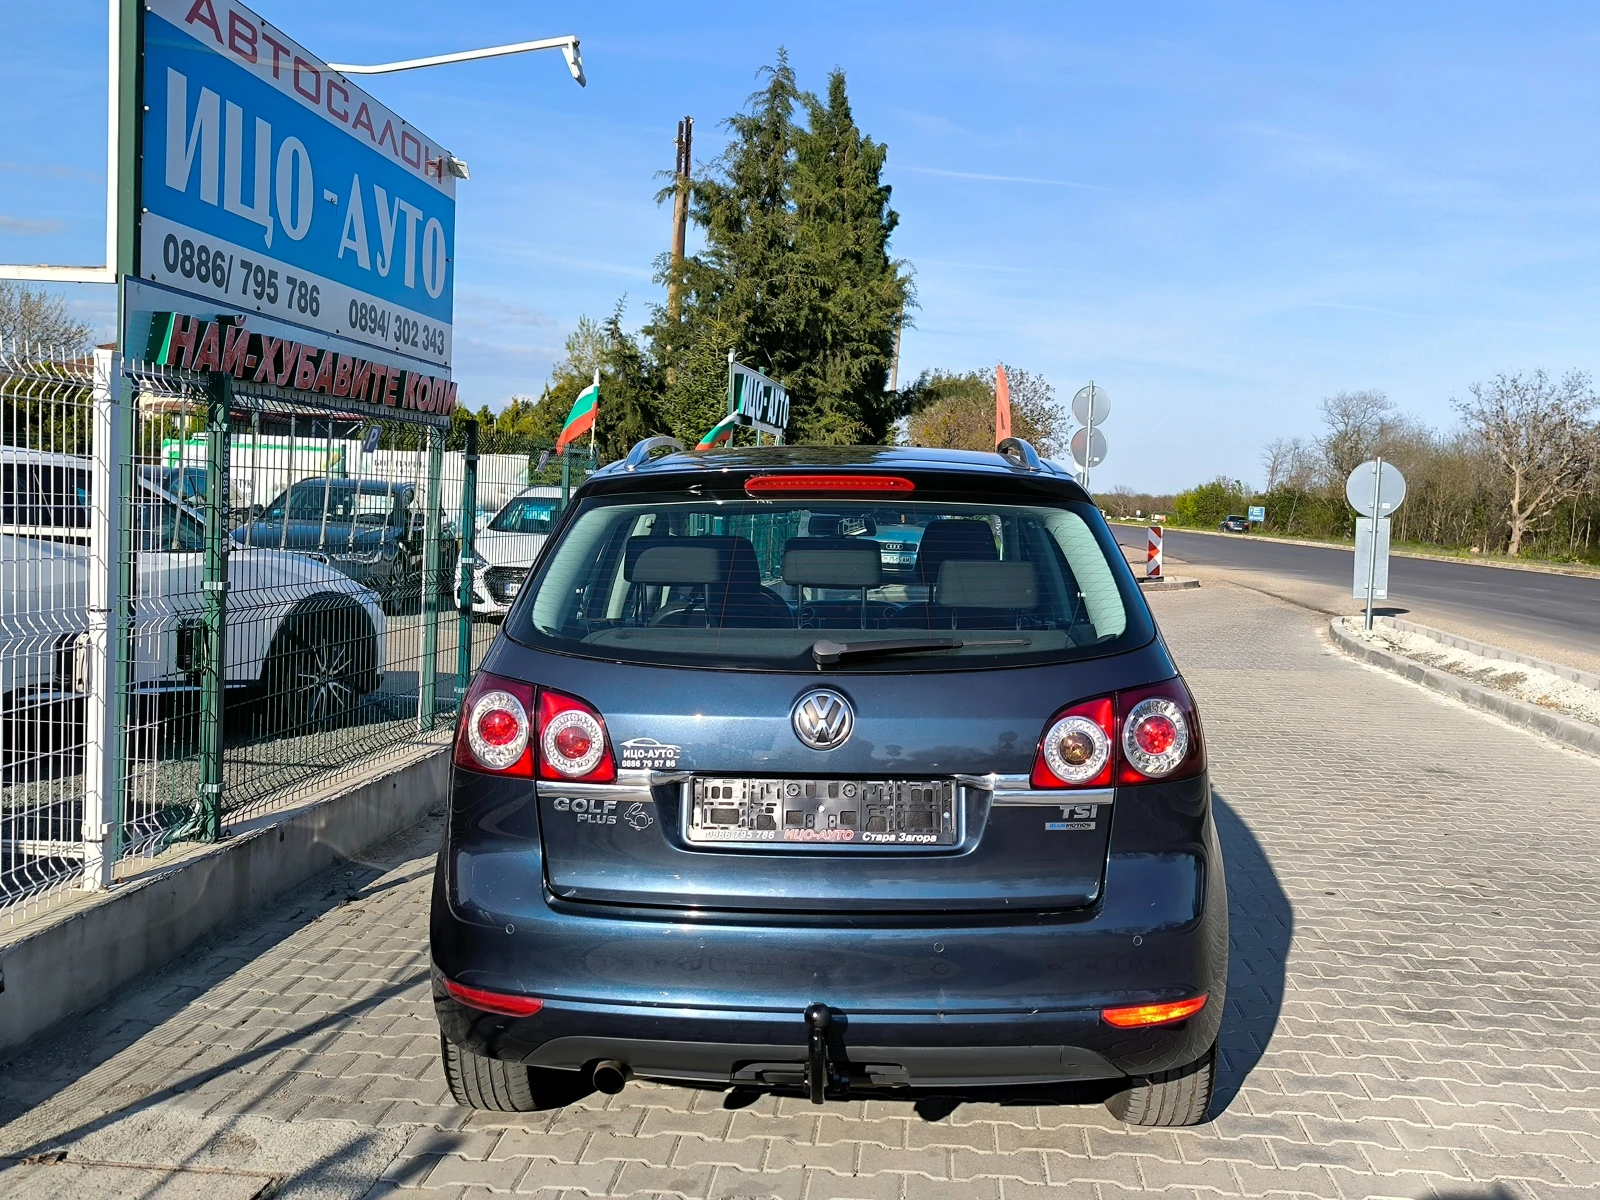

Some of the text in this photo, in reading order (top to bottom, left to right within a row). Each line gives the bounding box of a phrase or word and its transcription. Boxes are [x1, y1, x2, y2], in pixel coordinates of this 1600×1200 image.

[185, 0, 442, 184] АВТОСАЛОН
[165, 66, 446, 299] ИЦО-АУТО
[163, 233, 320, 318] 0886/ 795 786
[349, 299, 445, 356] 0894/ 302 343
[165, 311, 458, 416] НАЙ-ХУБАВИТЕ КОЛИ
[738, 374, 790, 429] ИЦО-АУТО
[366, 428, 379, 450] P
[222, 500, 229, 514] 79
[623, 749, 674, 760] ИЦО-АУТО
[553, 797, 617, 814] GOLF
[1060, 804, 1098, 819] TSI
[577, 813, 617, 825] PLUS
[734, 830, 753, 839] 795
[756, 831, 775, 839] 786
[783, 828, 854, 842] ИЦО-АУТО
[862, 831, 896, 843] Стара
[898, 832, 937, 844] Загора
